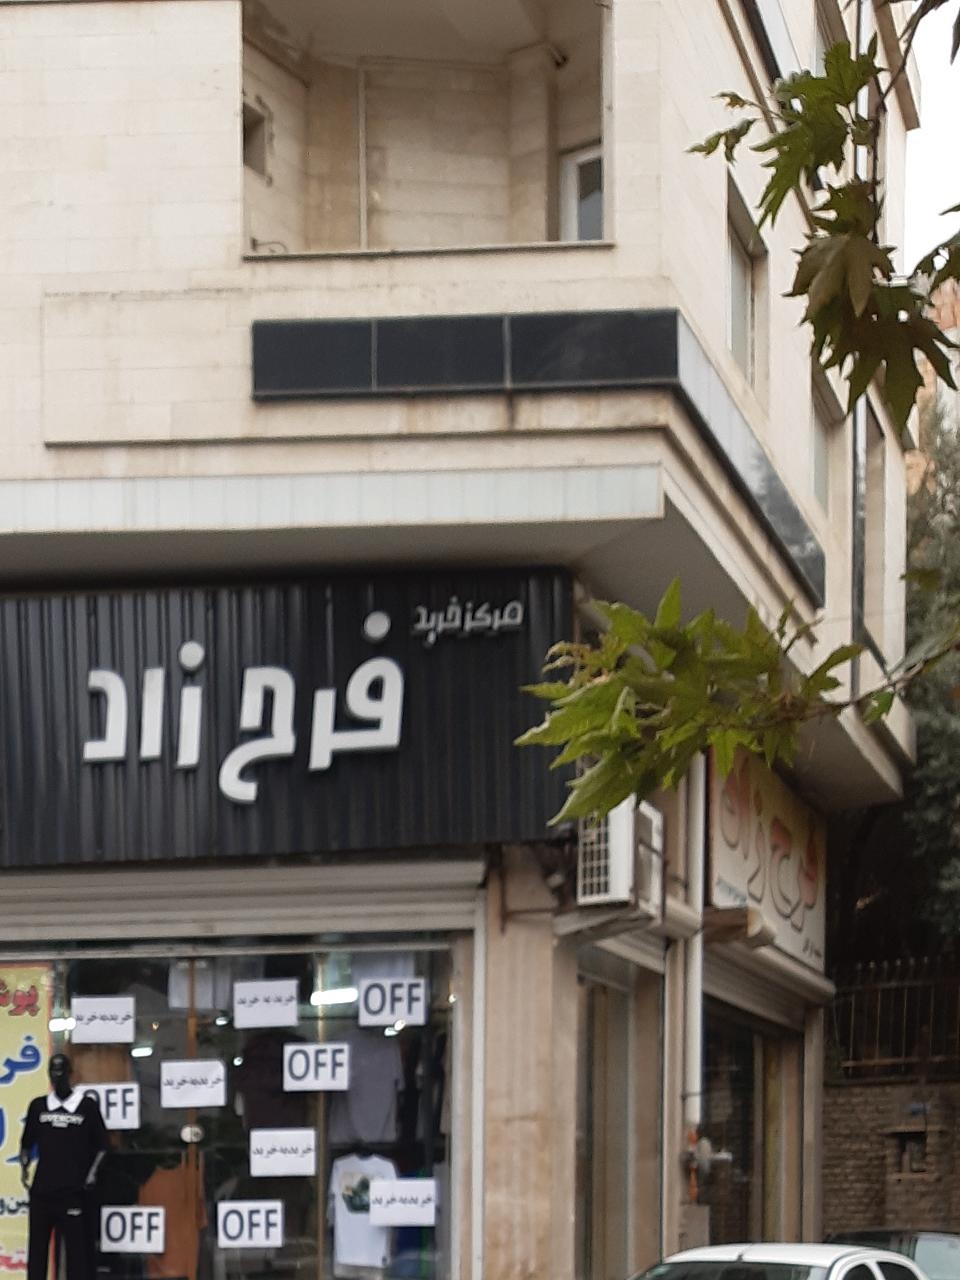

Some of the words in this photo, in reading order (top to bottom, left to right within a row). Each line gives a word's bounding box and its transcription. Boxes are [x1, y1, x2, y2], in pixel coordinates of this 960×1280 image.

[464, 600, 524, 633] مرکز
[83, 640, 206, 770] زاد
[218, 610, 404, 803] فرح
[363, 982, 421, 1015] OFF
[288, 1048, 345, 1082] OFF
[105, 1211, 160, 1243] OFF
[223, 1209, 278, 1241] OFF
